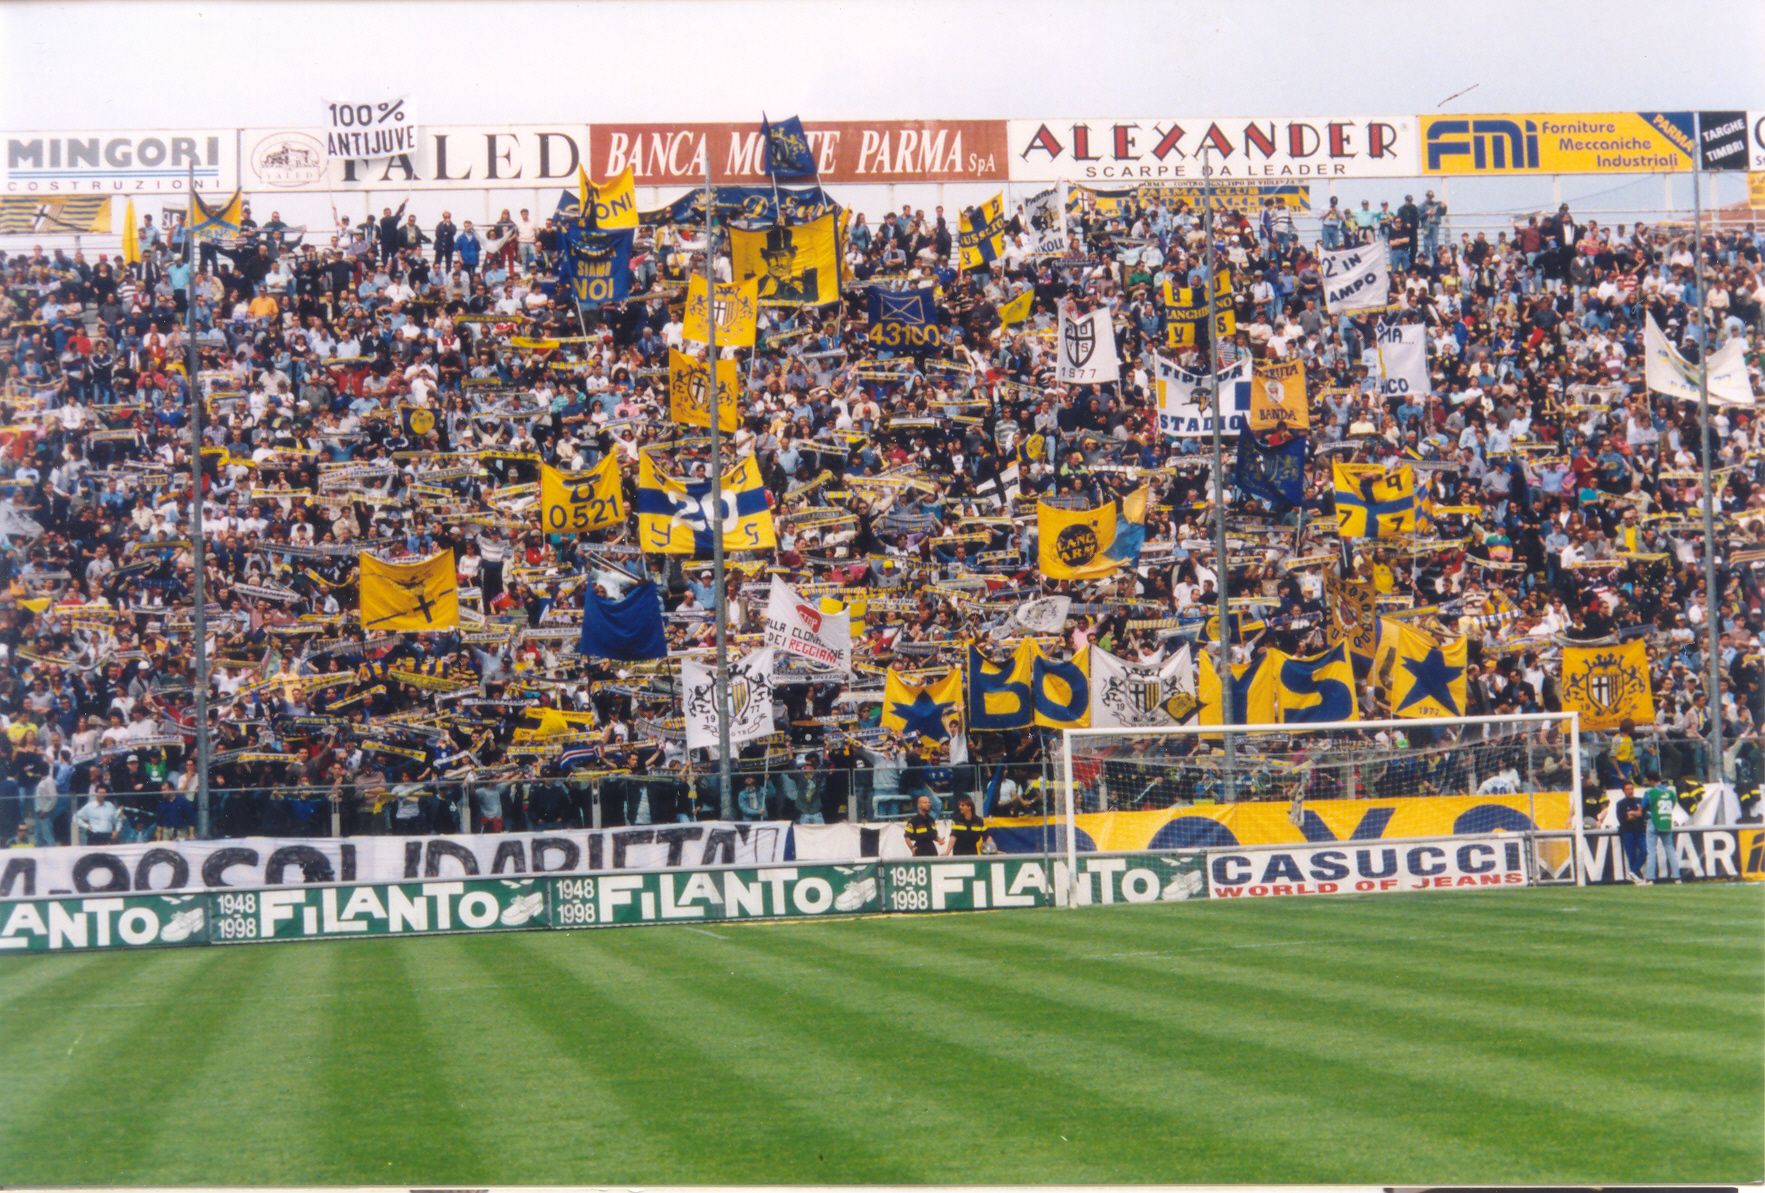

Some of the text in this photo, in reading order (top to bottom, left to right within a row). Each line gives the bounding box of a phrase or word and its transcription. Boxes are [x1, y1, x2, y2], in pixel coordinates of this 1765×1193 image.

[329, 99, 405, 127] 100%
[1541, 120, 1616, 134] Forniture
[1653, 113, 1694, 153] PARMA
[1702, 118, 1746, 143] TARGHE
[7, 136, 220, 169] MINGORI
[327, 125, 416, 157] ANTIJUVE
[1021, 119, 1399, 163] ALEXANDER
[1558, 135, 1652, 151] Meccaniche
[1705, 139, 1746, 163] TIMBRI
[605, 129, 996, 177] BANCA MOTE PARMA SpA
[1596, 151, 1679, 168] Industriali
[1085, 164, 1187, 178] SCARPE
[1248, 162, 1347, 177] LEADER
[7, 179, 221, 192] COSTRUZIONI
[1138, 186, 1260, 197] PARMA CLUB
[1342, 253, 1363, 272] IN
[1166, 297, 1233, 320] LANGHIRNO
[1060, 367, 1097, 380] 1977
[1159, 413, 1244, 432] STADIO
[1259, 408, 1298, 421] BANDA
[549, 494, 619, 529] 0521
[667, 488, 739, 534] 20
[1338, 508, 1353, 528] 7
[768, 632, 838, 664] DEI REGGIANI
[704, 704, 761, 724] 19 77
[1417, 706, 1442, 717] 1977
[1211, 842, 1523, 886] CASUCCI
[1580, 830, 1740, 882] VIAR
[889, 865, 928, 888] 1948
[1214, 872, 1524, 899] WORLD OF JEANS
[556, 878, 595, 900] 1948
[889, 888, 929, 911] 1998
[217, 893, 257, 916] 1948
[557, 901, 596, 925] 1998
[0, 897, 160, 949] ANTO
[218, 917, 258, 940] 1998
